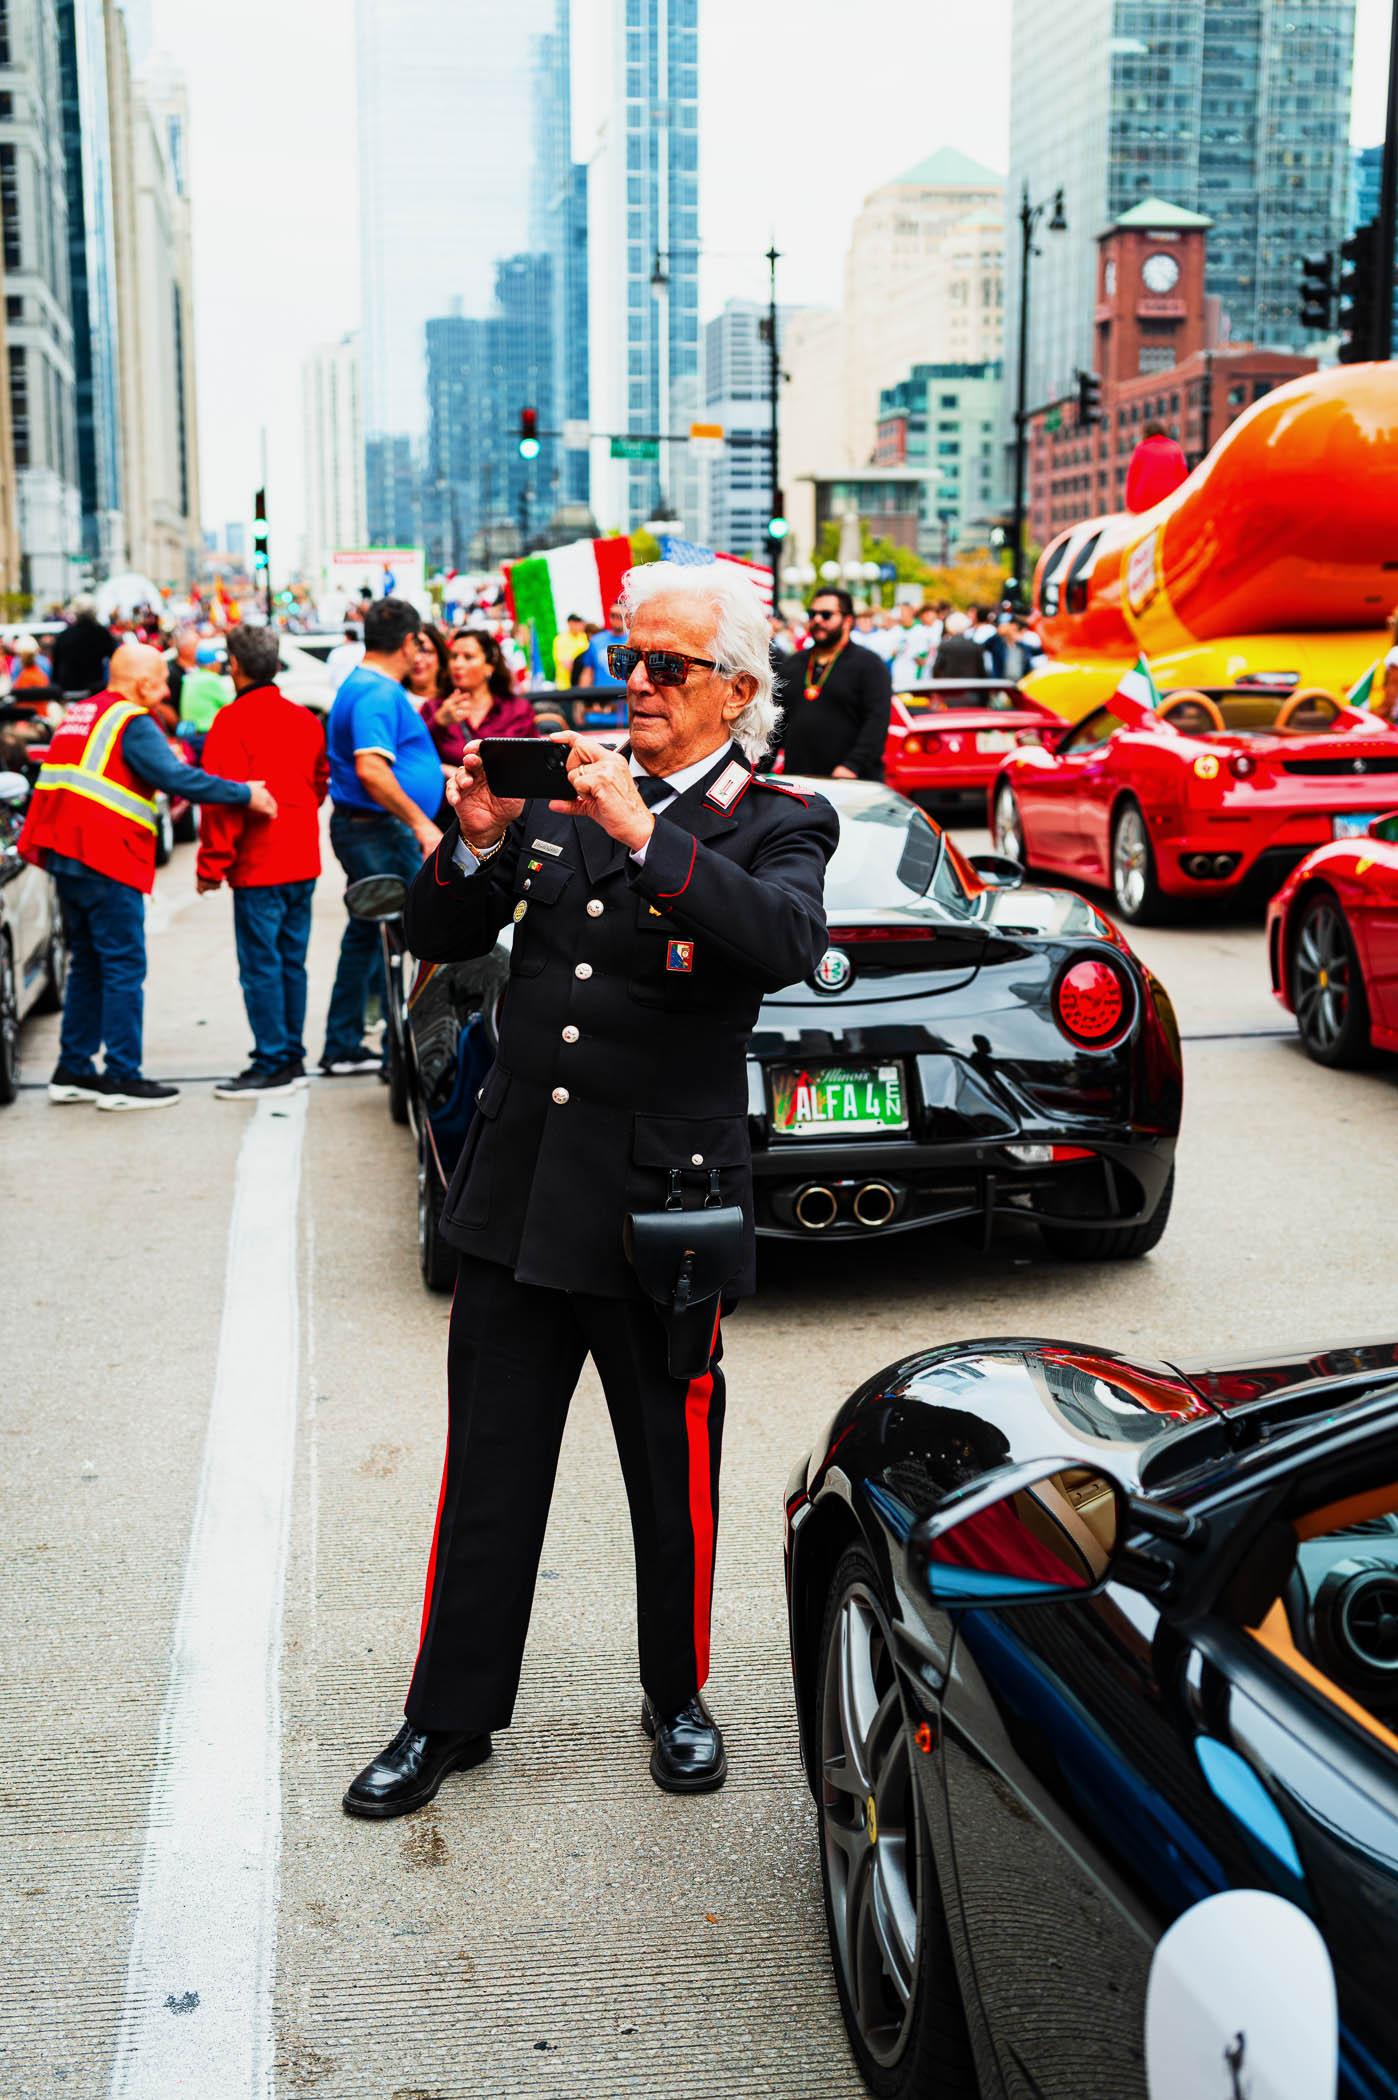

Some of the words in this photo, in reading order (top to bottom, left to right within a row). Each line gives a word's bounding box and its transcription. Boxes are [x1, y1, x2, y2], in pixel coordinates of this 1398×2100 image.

[819, 1068, 870, 1083] Illinois
[796, 1084, 858, 1121] ALFA
[866, 1083, 880, 1117] 4
[886, 1081, 901, 1116] EN
